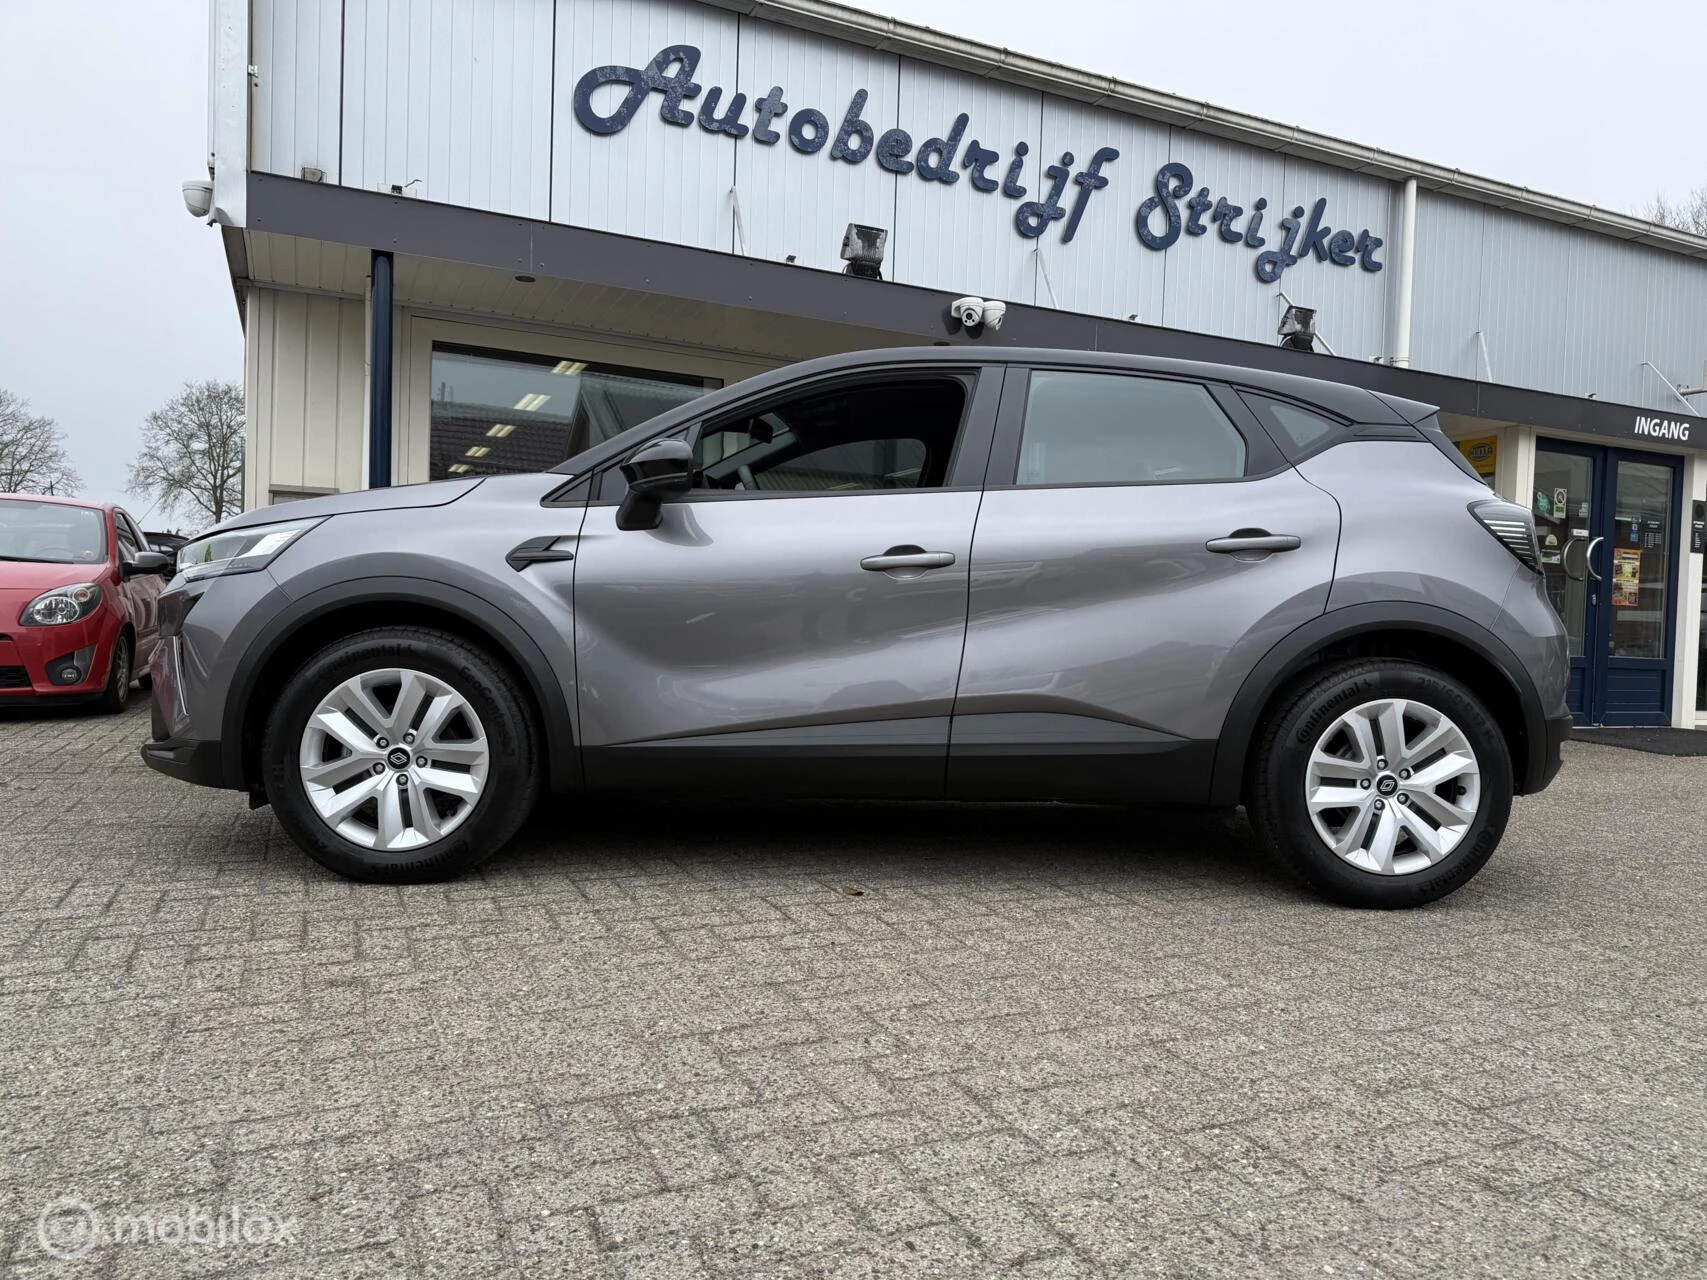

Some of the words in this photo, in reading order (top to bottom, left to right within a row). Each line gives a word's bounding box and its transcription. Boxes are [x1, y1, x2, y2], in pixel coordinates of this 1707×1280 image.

[574, 45, 1120, 243] Autobedrijf
[1136, 162, 1384, 283] Strijker
[1634, 416, 1690, 441] INGANG
[1296, 682, 1361, 744] Continental
